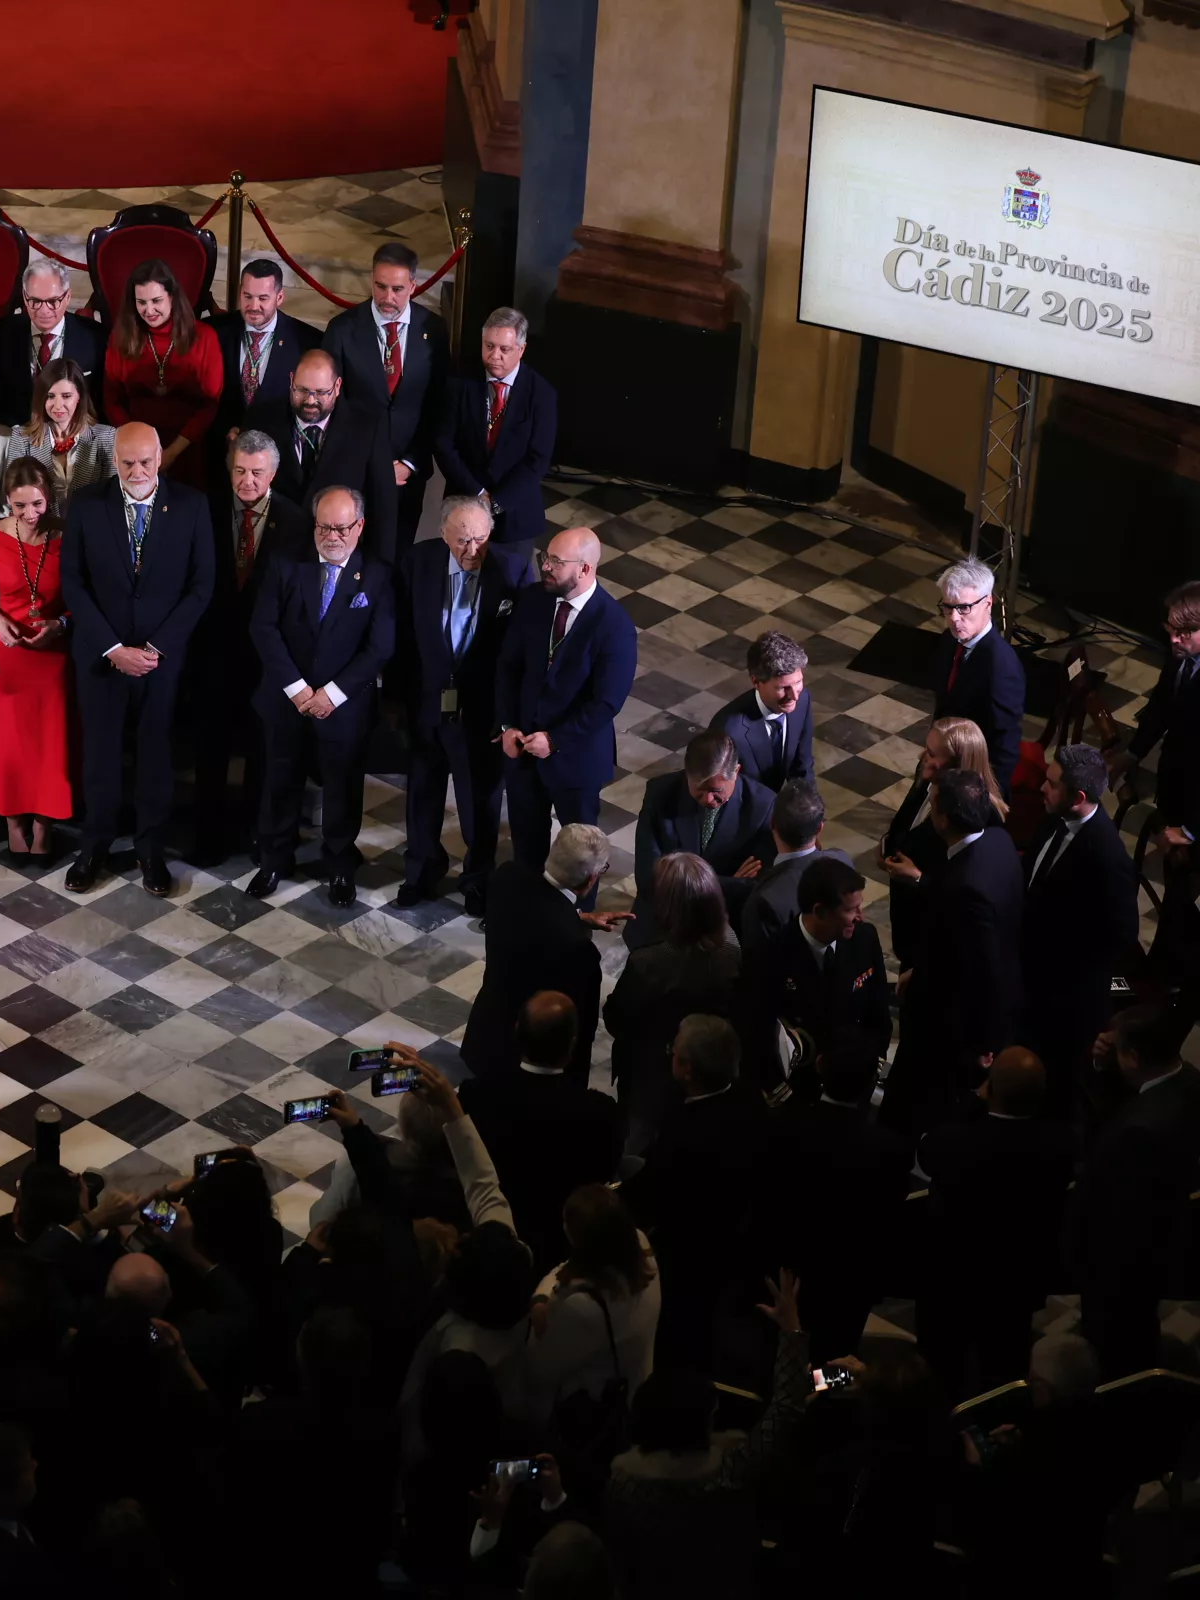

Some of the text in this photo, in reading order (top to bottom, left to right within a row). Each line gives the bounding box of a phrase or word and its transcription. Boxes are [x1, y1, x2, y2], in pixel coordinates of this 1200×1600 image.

[883, 247, 1153, 343] Cádiz 2025
[894, 217, 1149, 294] Día de la Provincia de
